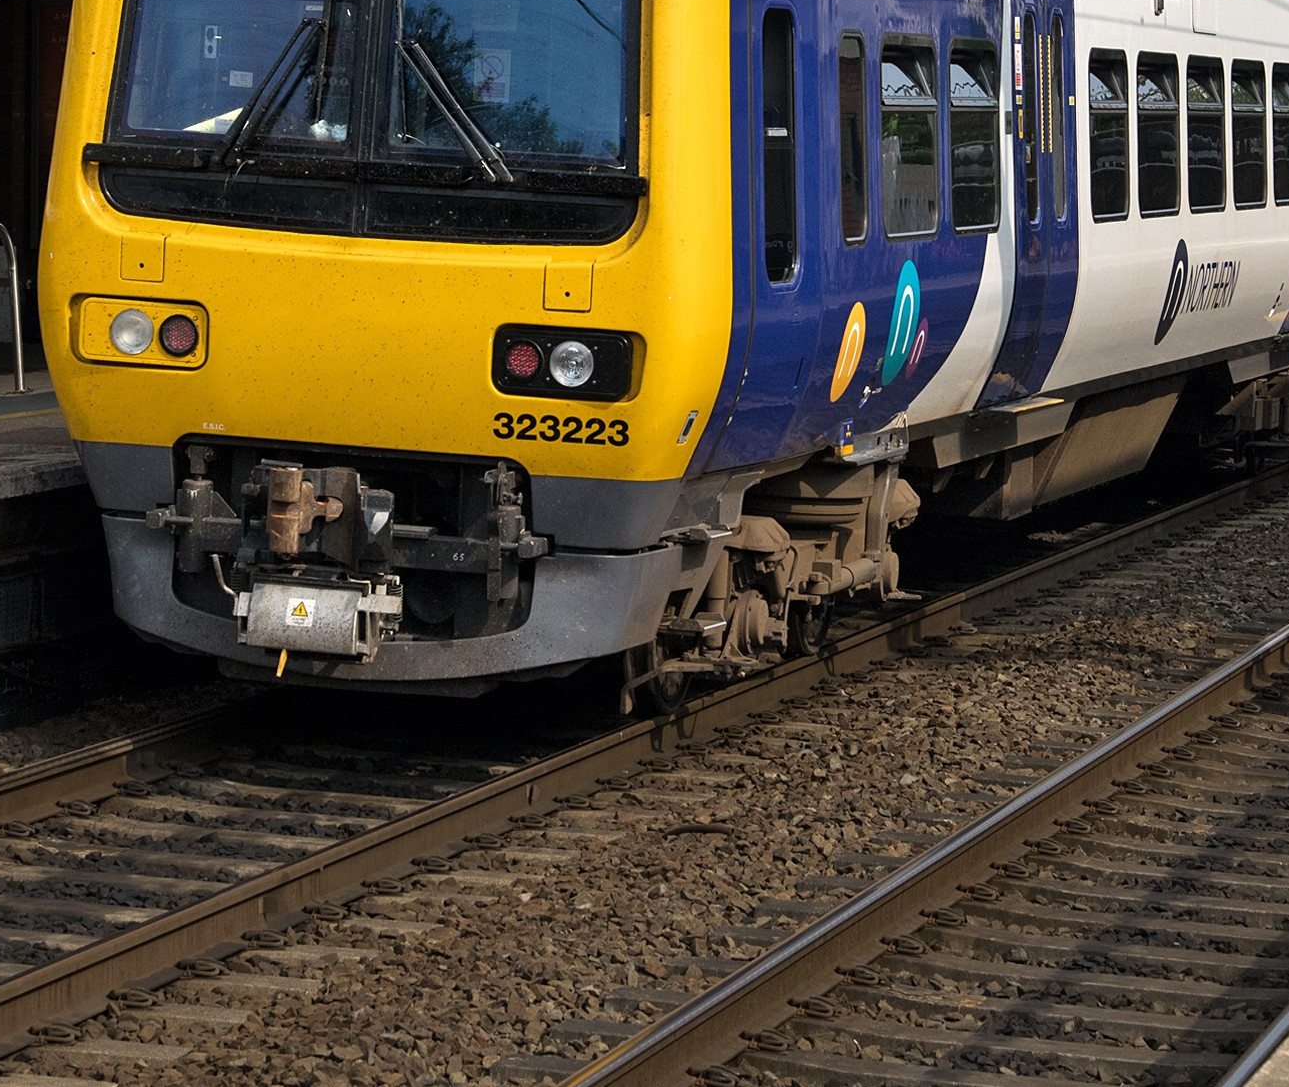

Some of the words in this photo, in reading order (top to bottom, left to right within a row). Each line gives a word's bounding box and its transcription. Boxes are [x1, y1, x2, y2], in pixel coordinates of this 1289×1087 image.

[1180, 260, 1242, 315] NORTHERN
[492, 411, 630, 447] 323223
[452, 551, 465, 562] 65
